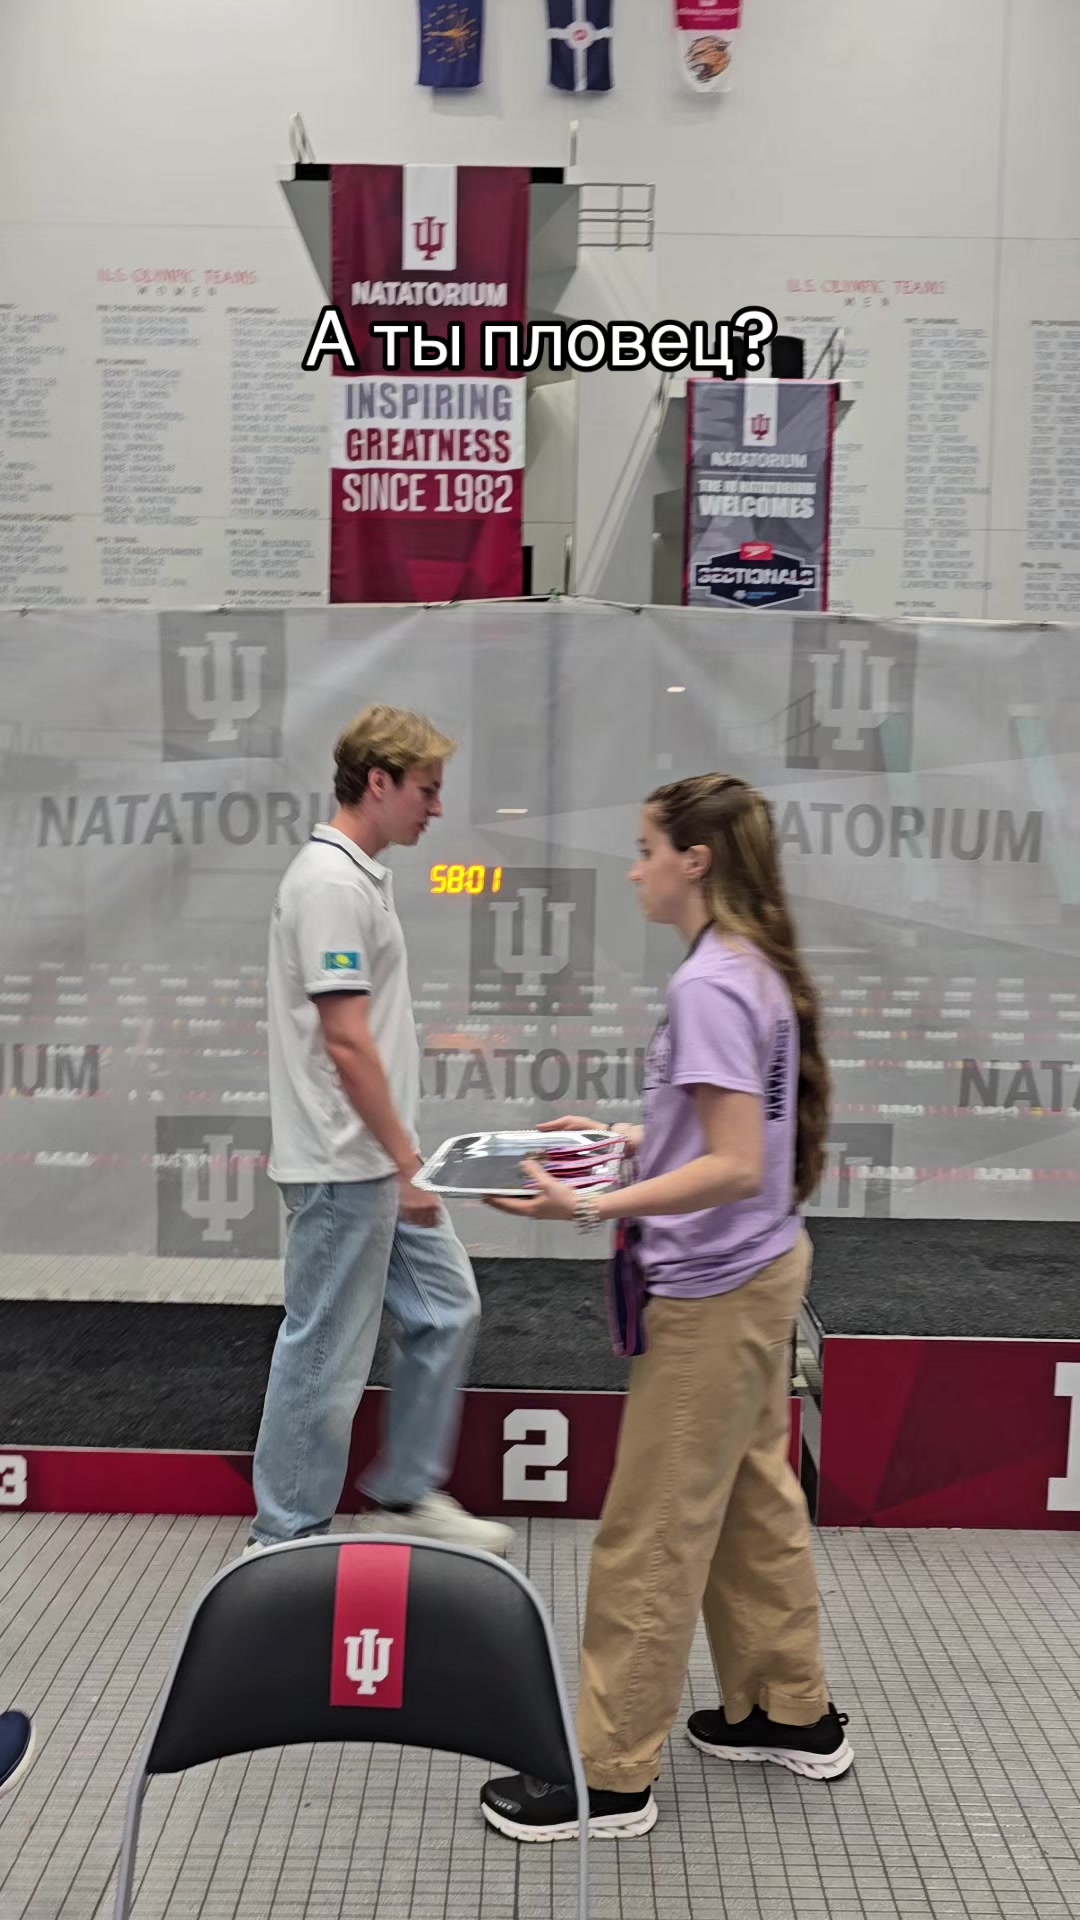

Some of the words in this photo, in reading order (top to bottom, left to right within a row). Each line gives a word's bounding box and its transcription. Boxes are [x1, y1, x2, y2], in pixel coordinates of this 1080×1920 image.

[351, 280, 508, 307] NATATORIUM
[893, 280, 945, 295] TEAMS
[345, 382, 513, 421] INSPIRING
[346, 427, 512, 464] GREATNESS
[710, 451, 808, 468] NATATORIUM
[342, 472, 428, 513] SINCE
[433, 473, 513, 514] 1982
[699, 495, 815, 519] WELCOMES
[697, 567, 814, 586] SECTIONALS
[37, 791, 336, 847] NATATORI
[773, 800, 1043, 862] ATORIUM
[421, 1047, 645, 1102] TATORI
[959, 1058, 1080, 1112] NAT
[503, 1408, 569, 1502] 2
[0, 1454, 28, 1506] 3
